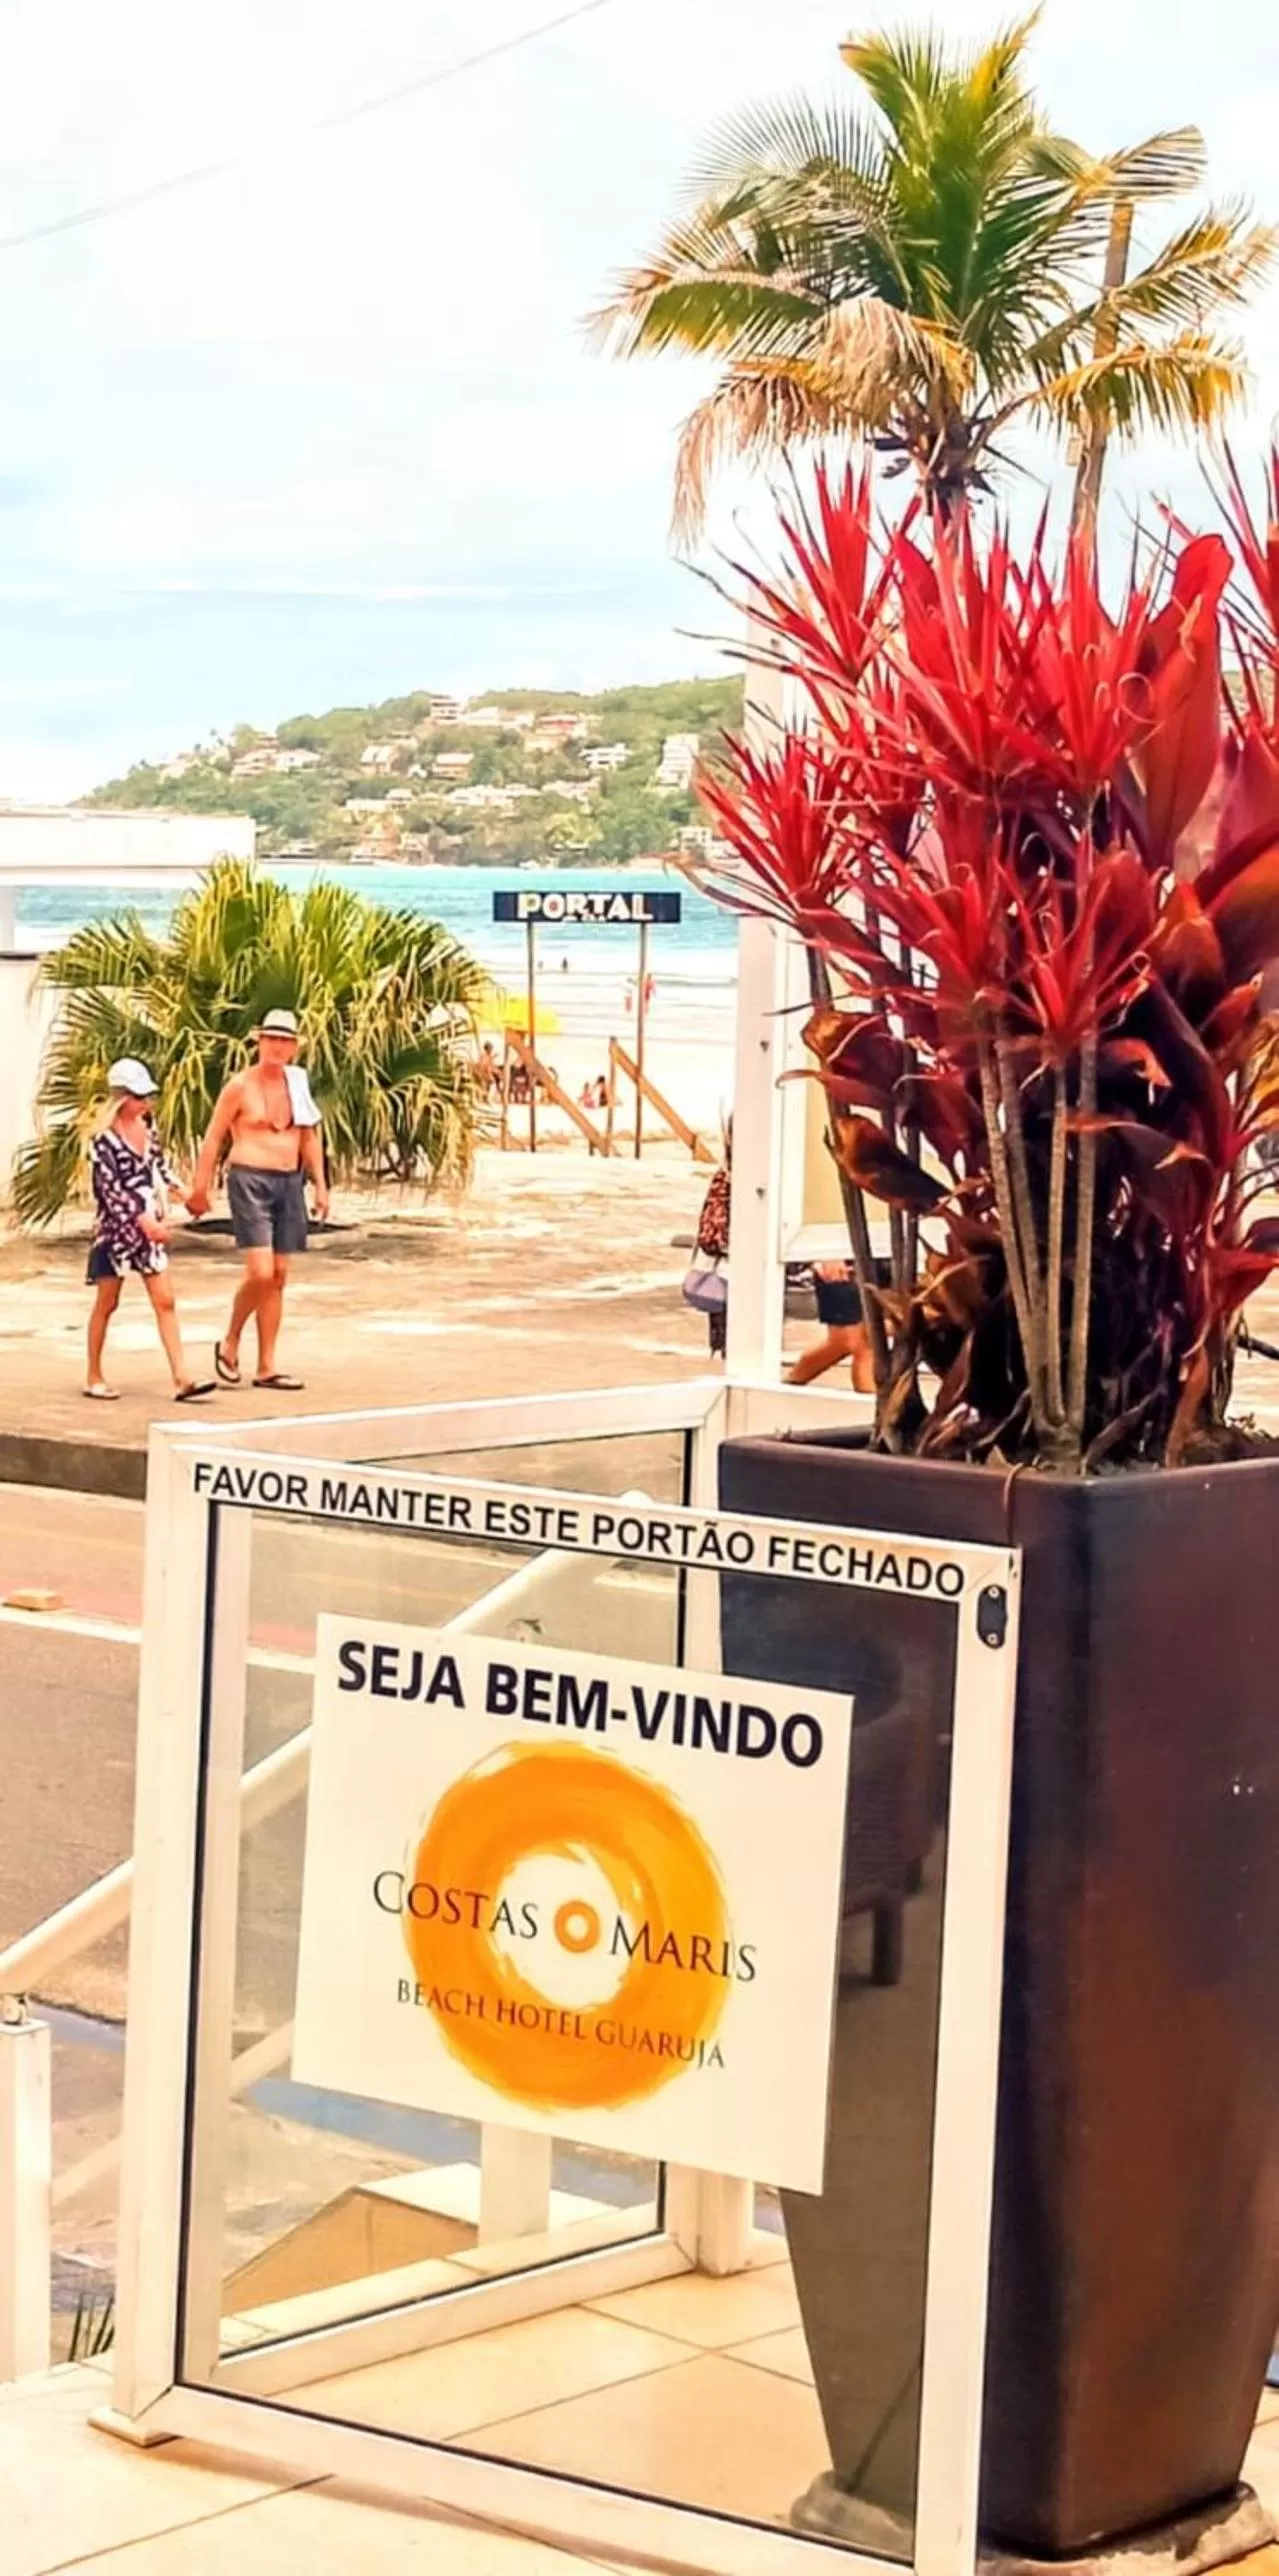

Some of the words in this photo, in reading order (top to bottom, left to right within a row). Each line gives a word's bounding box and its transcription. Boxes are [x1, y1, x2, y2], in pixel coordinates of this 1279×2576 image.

[517, 892, 653, 920] PORTAL
[194, 1463, 308, 1505] FAVOR
[321, 1480, 471, 1528] MANTER
[485, 1502, 579, 1542] ESTE
[592, 1512, 754, 1564] PORTÃO
[768, 1536, 965, 1596] FECHADO
[338, 1641, 465, 1709] SEJA
[485, 1662, 824, 1768] BEM-VINDO
[397, 1979, 486, 2021] BEACH
[496, 1999, 587, 2040] HOTEL
